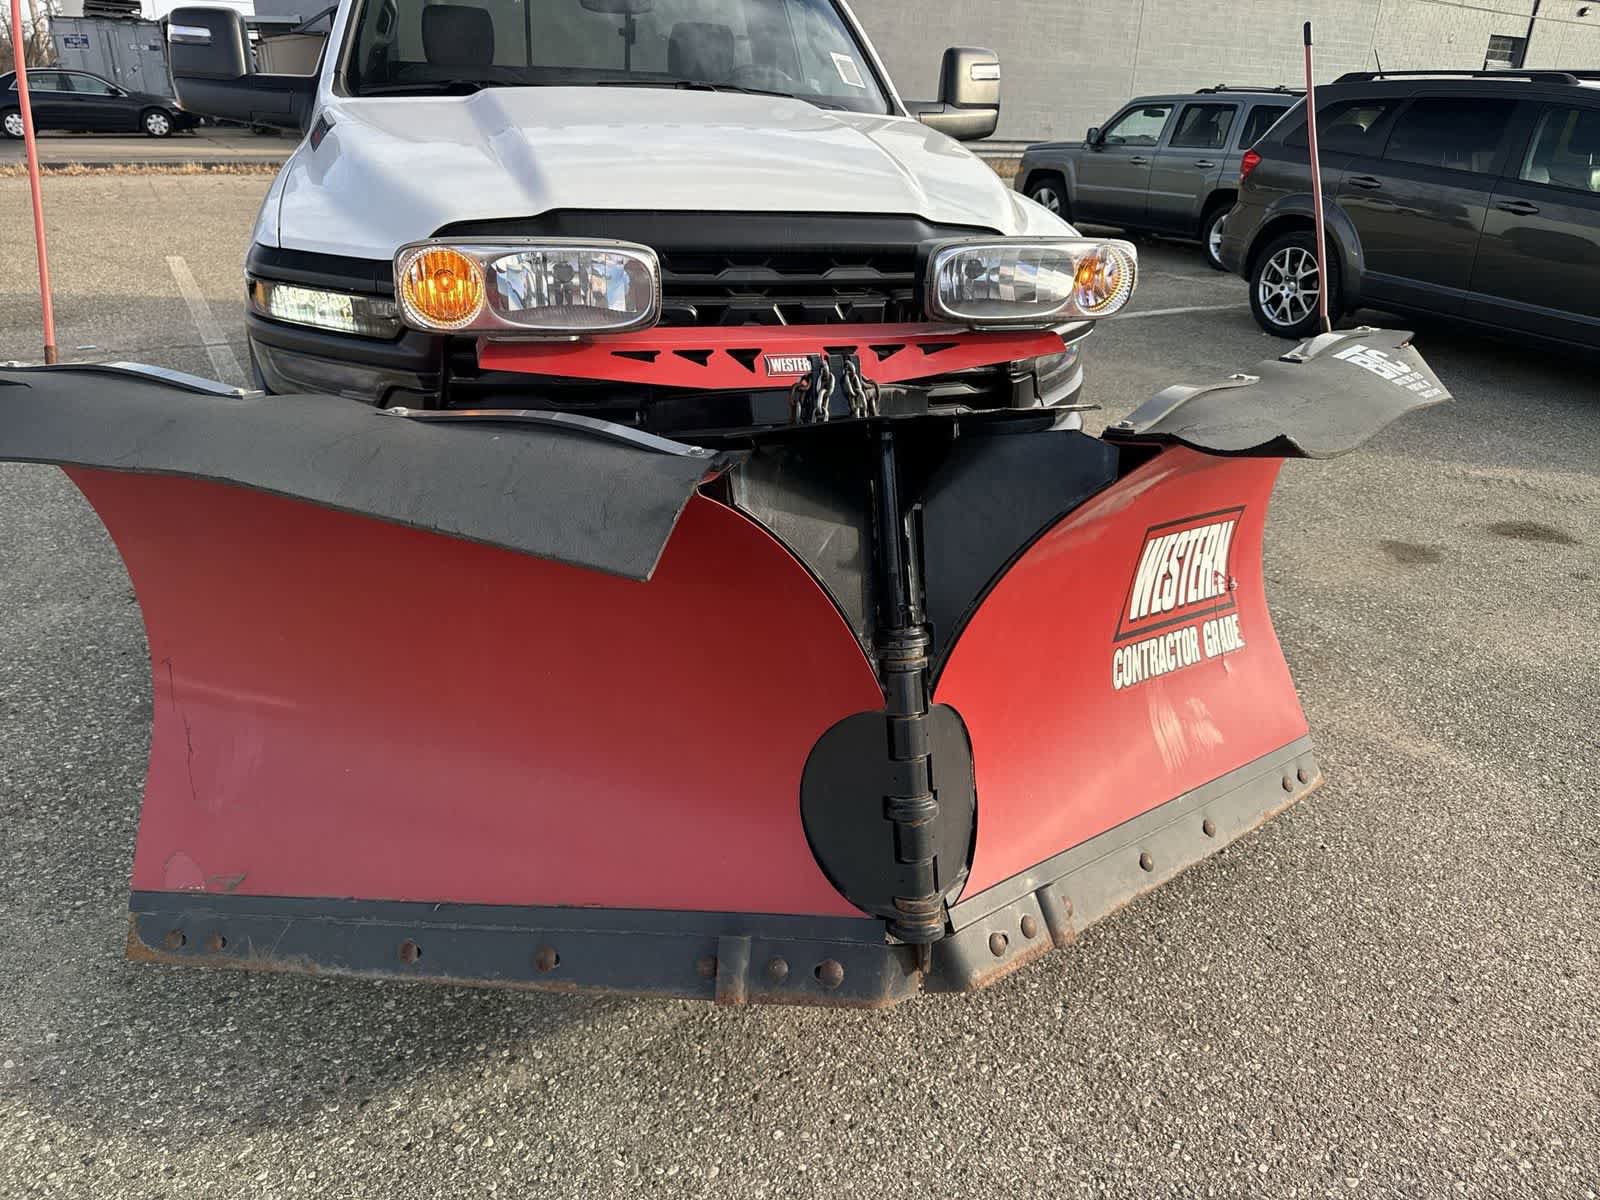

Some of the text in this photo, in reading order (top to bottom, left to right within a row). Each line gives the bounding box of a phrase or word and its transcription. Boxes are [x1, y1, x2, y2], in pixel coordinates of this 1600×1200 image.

[770, 357, 812, 372] WESTER
[1129, 520, 1236, 622] WESTERN
[1112, 613, 1246, 690] CONTRACTOR GRADE
